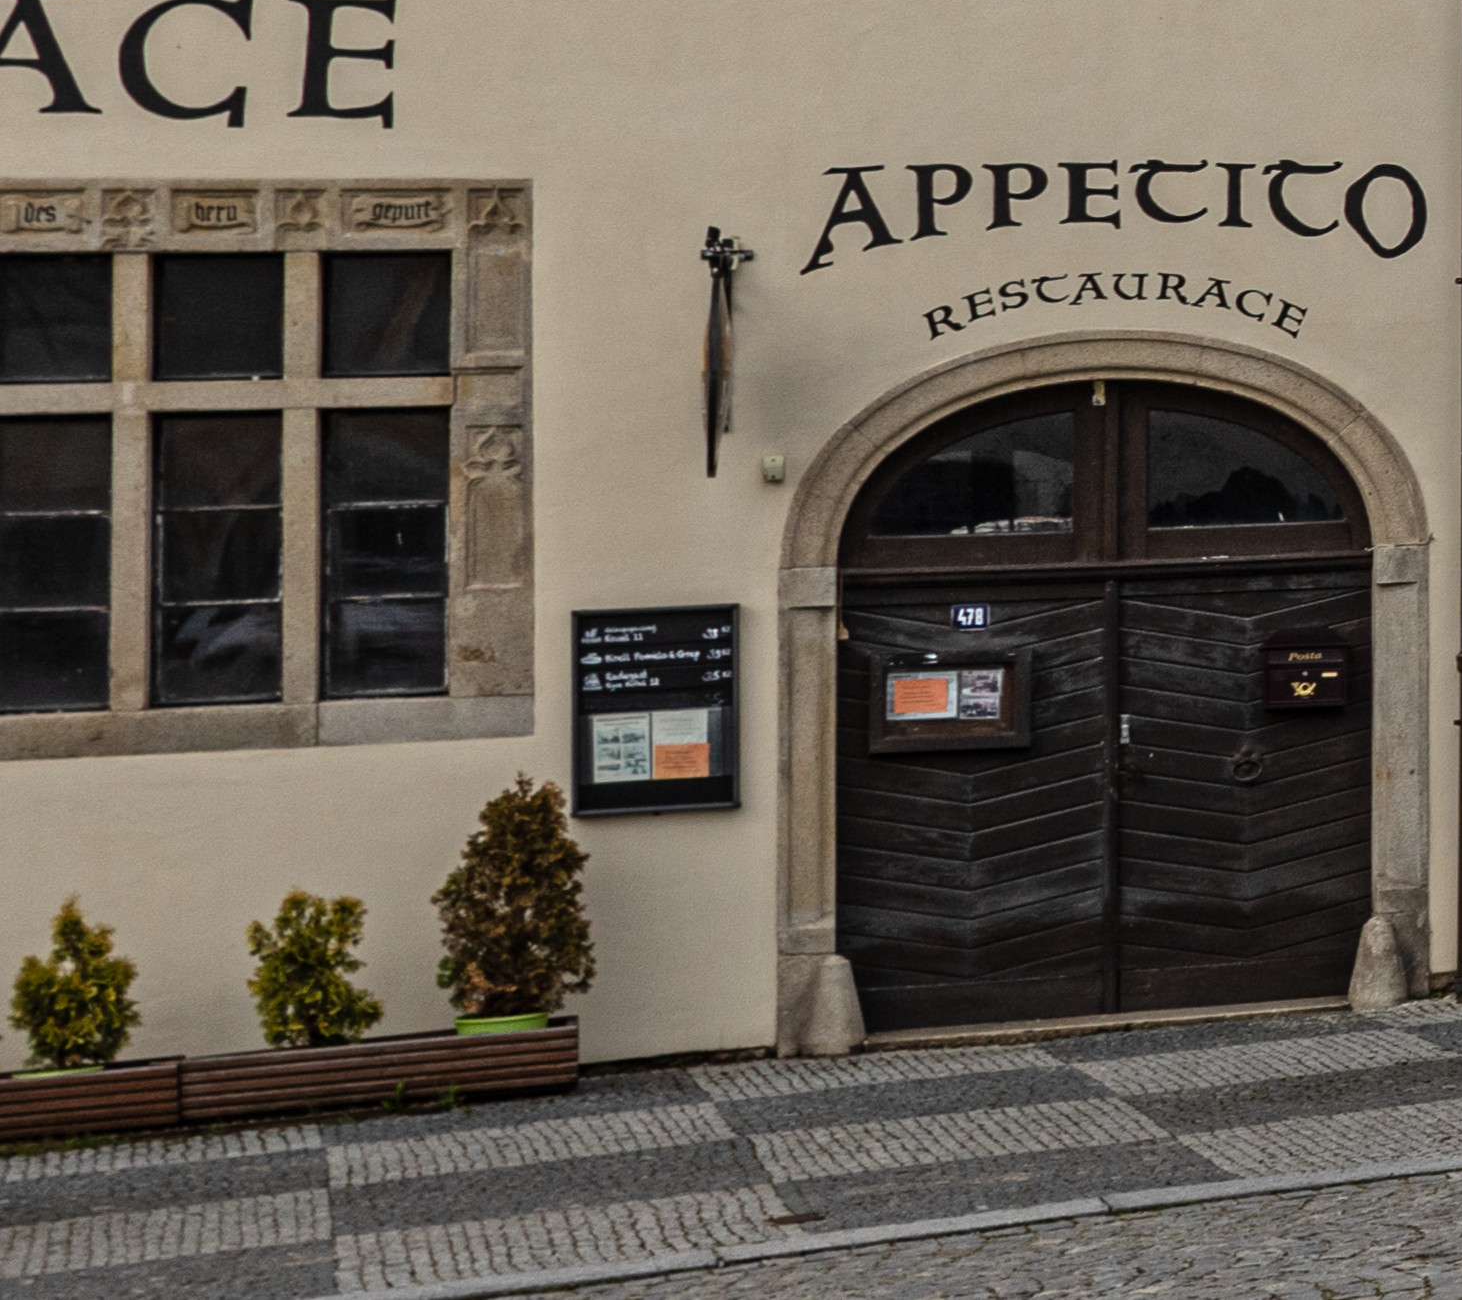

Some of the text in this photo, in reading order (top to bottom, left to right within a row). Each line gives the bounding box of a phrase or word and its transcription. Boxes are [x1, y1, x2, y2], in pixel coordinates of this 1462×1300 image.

[800, 160, 1427, 275] APPETITO
[922, 272, 1308, 340] RESTAURACE
[957, 608, 984, 625] 478
